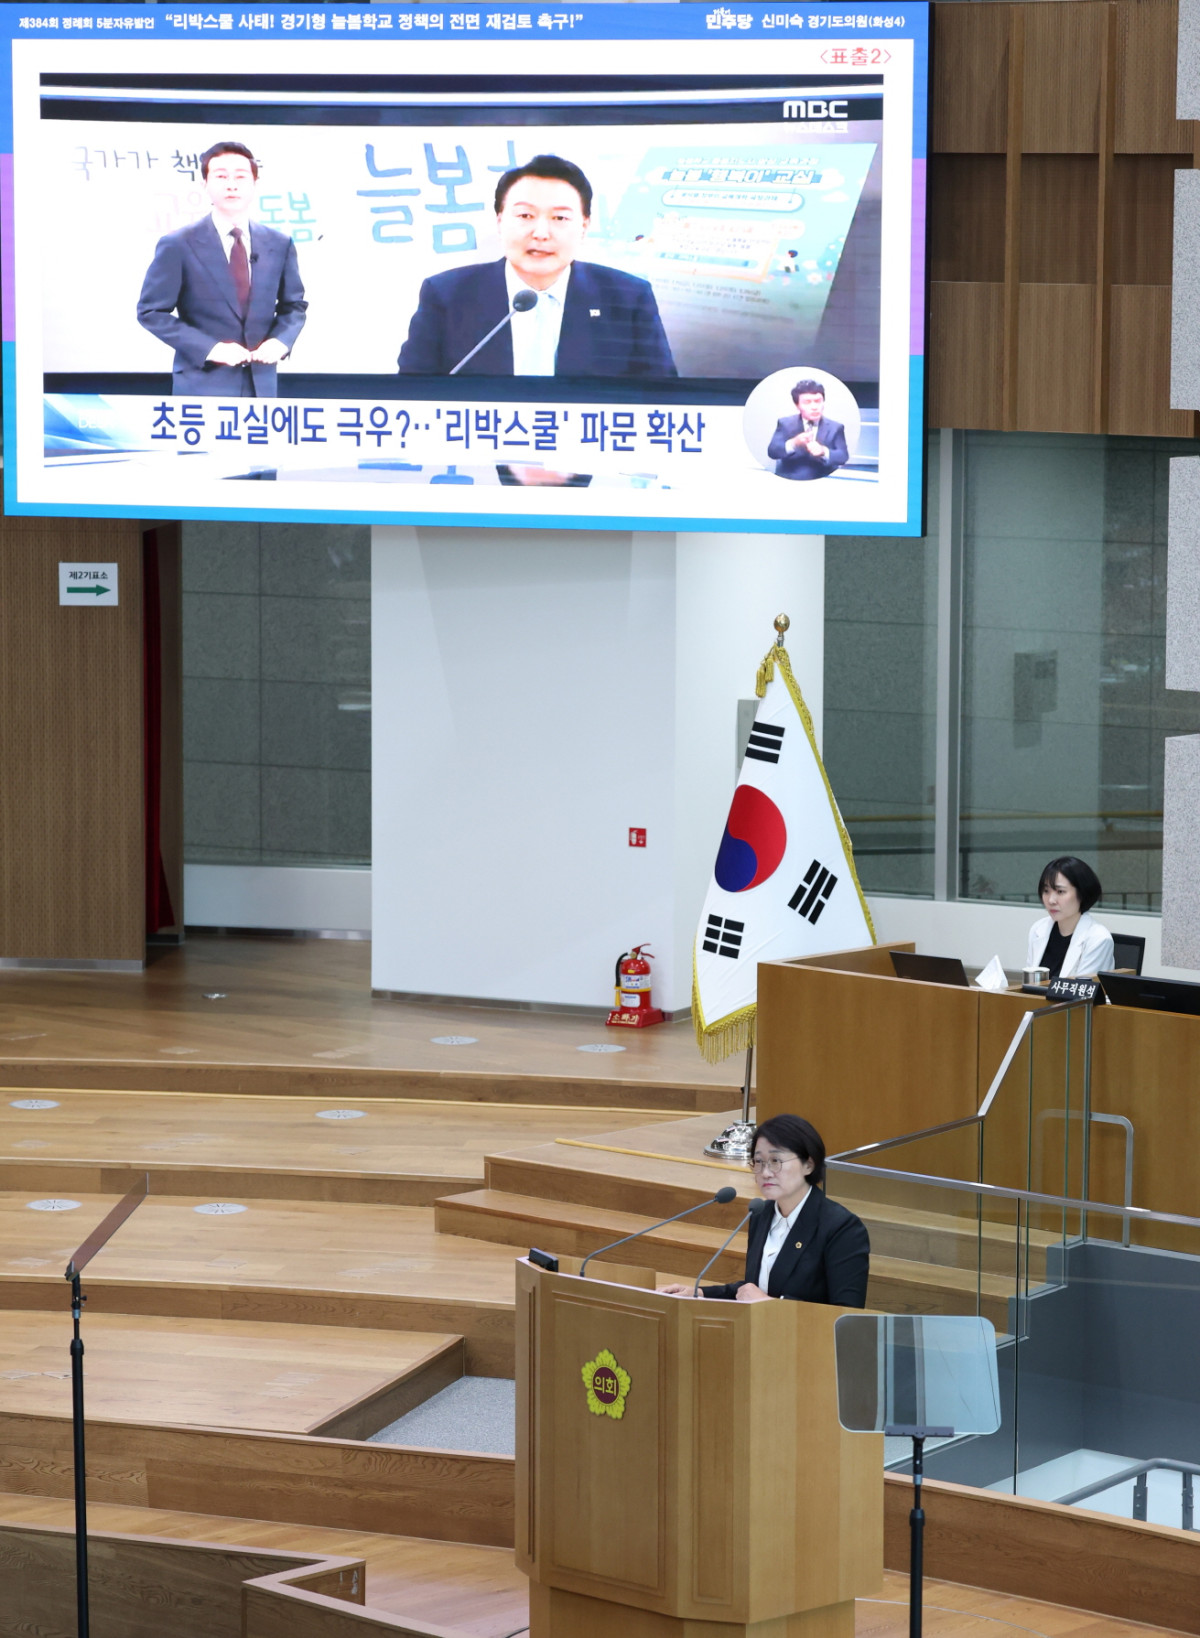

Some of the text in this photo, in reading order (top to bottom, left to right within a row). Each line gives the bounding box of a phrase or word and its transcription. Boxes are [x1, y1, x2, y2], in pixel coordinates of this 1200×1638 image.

[18, 17, 155, 29] 제384회 정례회 5분자유발언
[239, 13, 275, 30] 사태!
[281, 13, 326, 30] 경기형
[331, 13, 393, 30] 늘봄학교
[398, 13, 444, 30] 정책의
[449, 13, 480, 30] 전면
[485, 13, 532, 30] 재검토
[706, 14, 753, 29] 민주당
[761, 14, 804, 29] 신미숙
[783, 100, 848, 118] MBC
[151, 401, 206, 446] 초등
[215, 404, 328, 446] 교실에도
[580, 410, 638, 452] 파문
[646, 409, 706, 453] 확산
[68, 571, 109, 580] 제2기표소
[1051, 980, 1096, 998] 사무직원석
[593, 1376, 618, 1396] 의회
